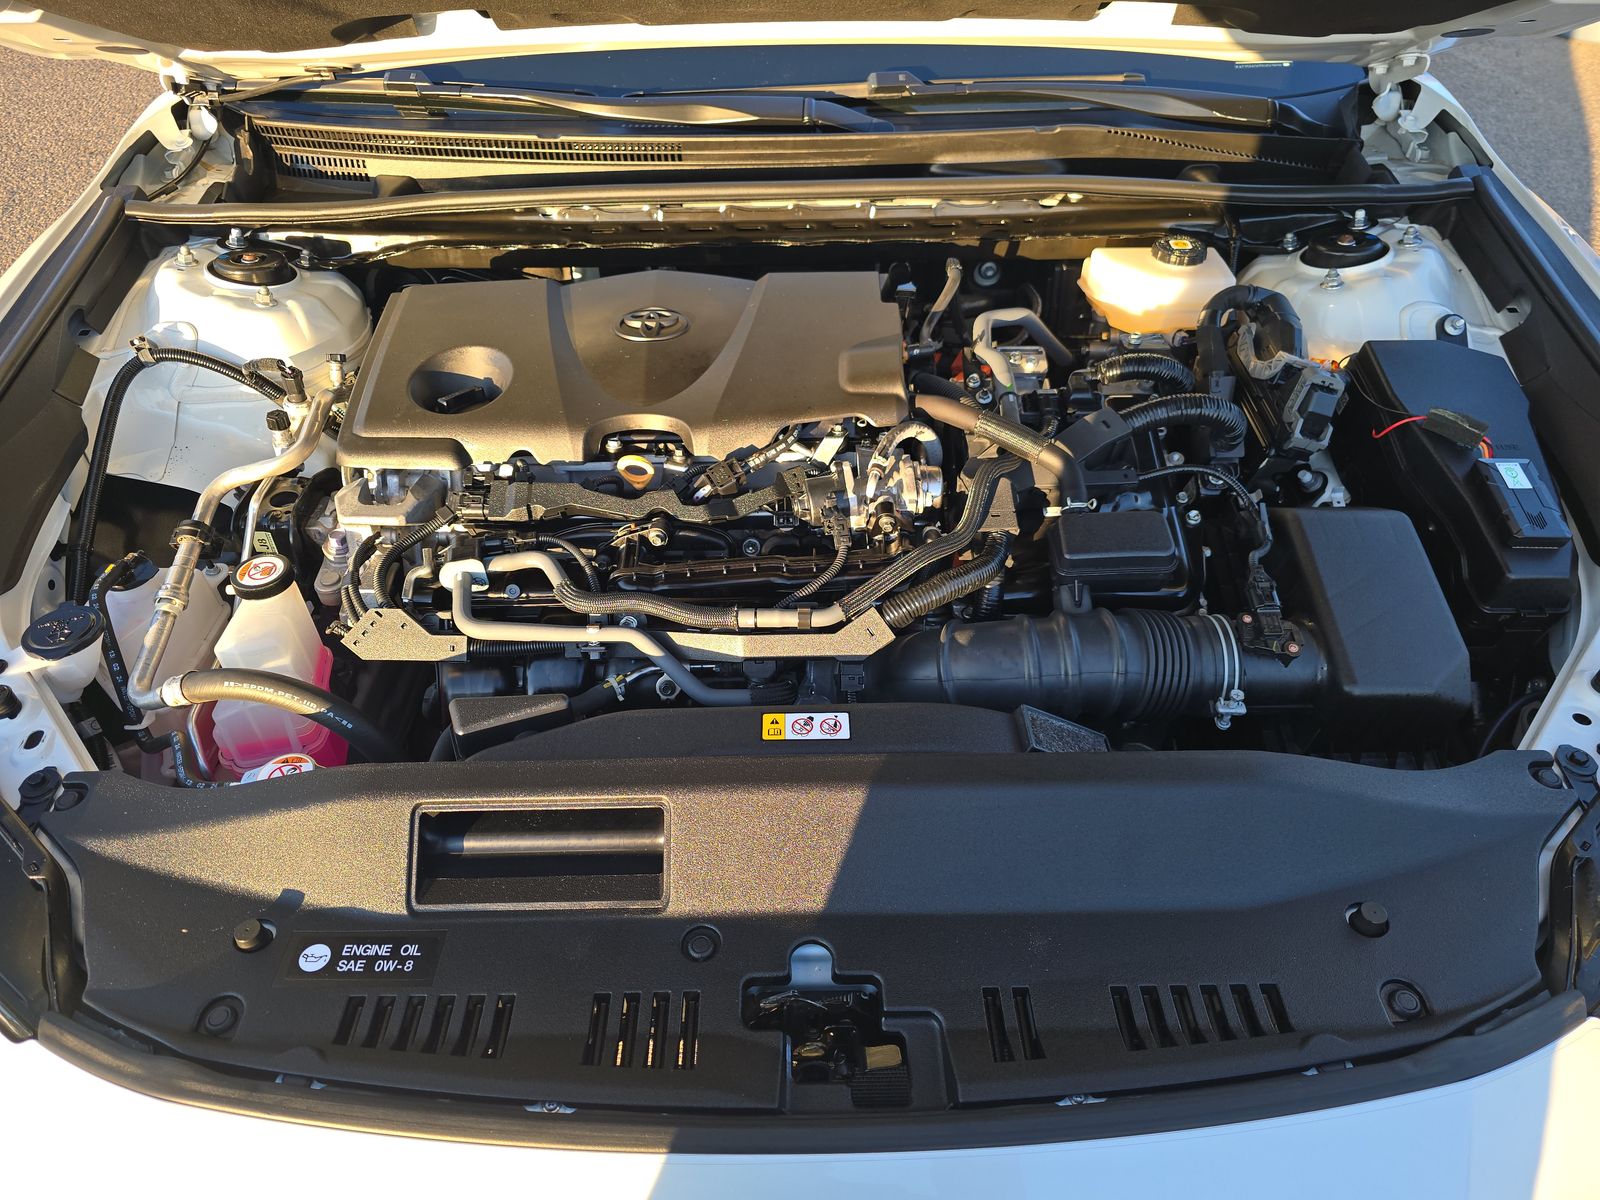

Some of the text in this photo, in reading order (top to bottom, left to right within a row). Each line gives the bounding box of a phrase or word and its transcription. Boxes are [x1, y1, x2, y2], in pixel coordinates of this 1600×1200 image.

[257, 538, 270, 550] J8
[341, 944, 422, 956] ENGINE OIL
[336, 960, 414, 972] SAE 0W-8
